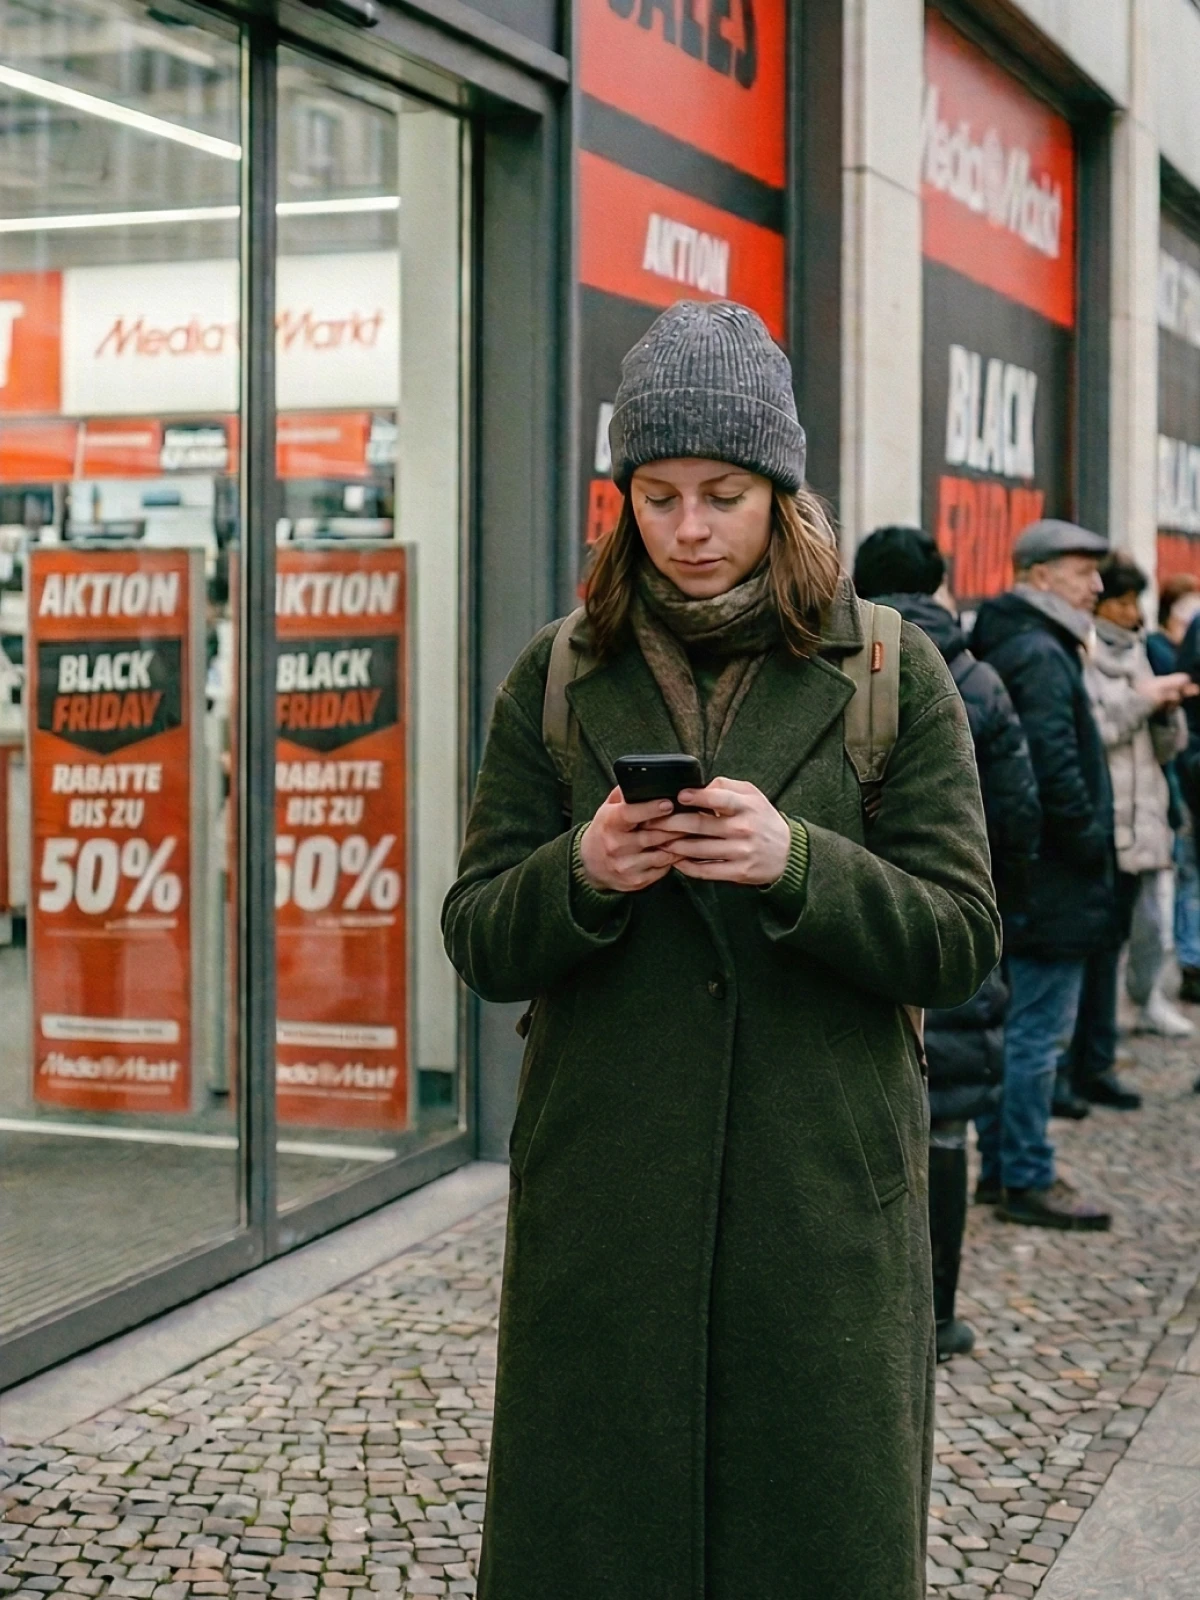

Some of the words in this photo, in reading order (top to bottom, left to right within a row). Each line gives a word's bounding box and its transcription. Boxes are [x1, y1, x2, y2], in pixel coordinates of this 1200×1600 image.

[38, 571, 180, 618] AKTION
[58, 650, 154, 693] BLACK
[275, 648, 371, 692] BLACK
[52, 690, 165, 733] FRIDAY
[52, 762, 163, 794] RABATTE
[68, 798, 108, 829] BIS
[108, 798, 145, 829] ZU
[327, 795, 364, 827] ZU
[38, 835, 182, 914] 50%
